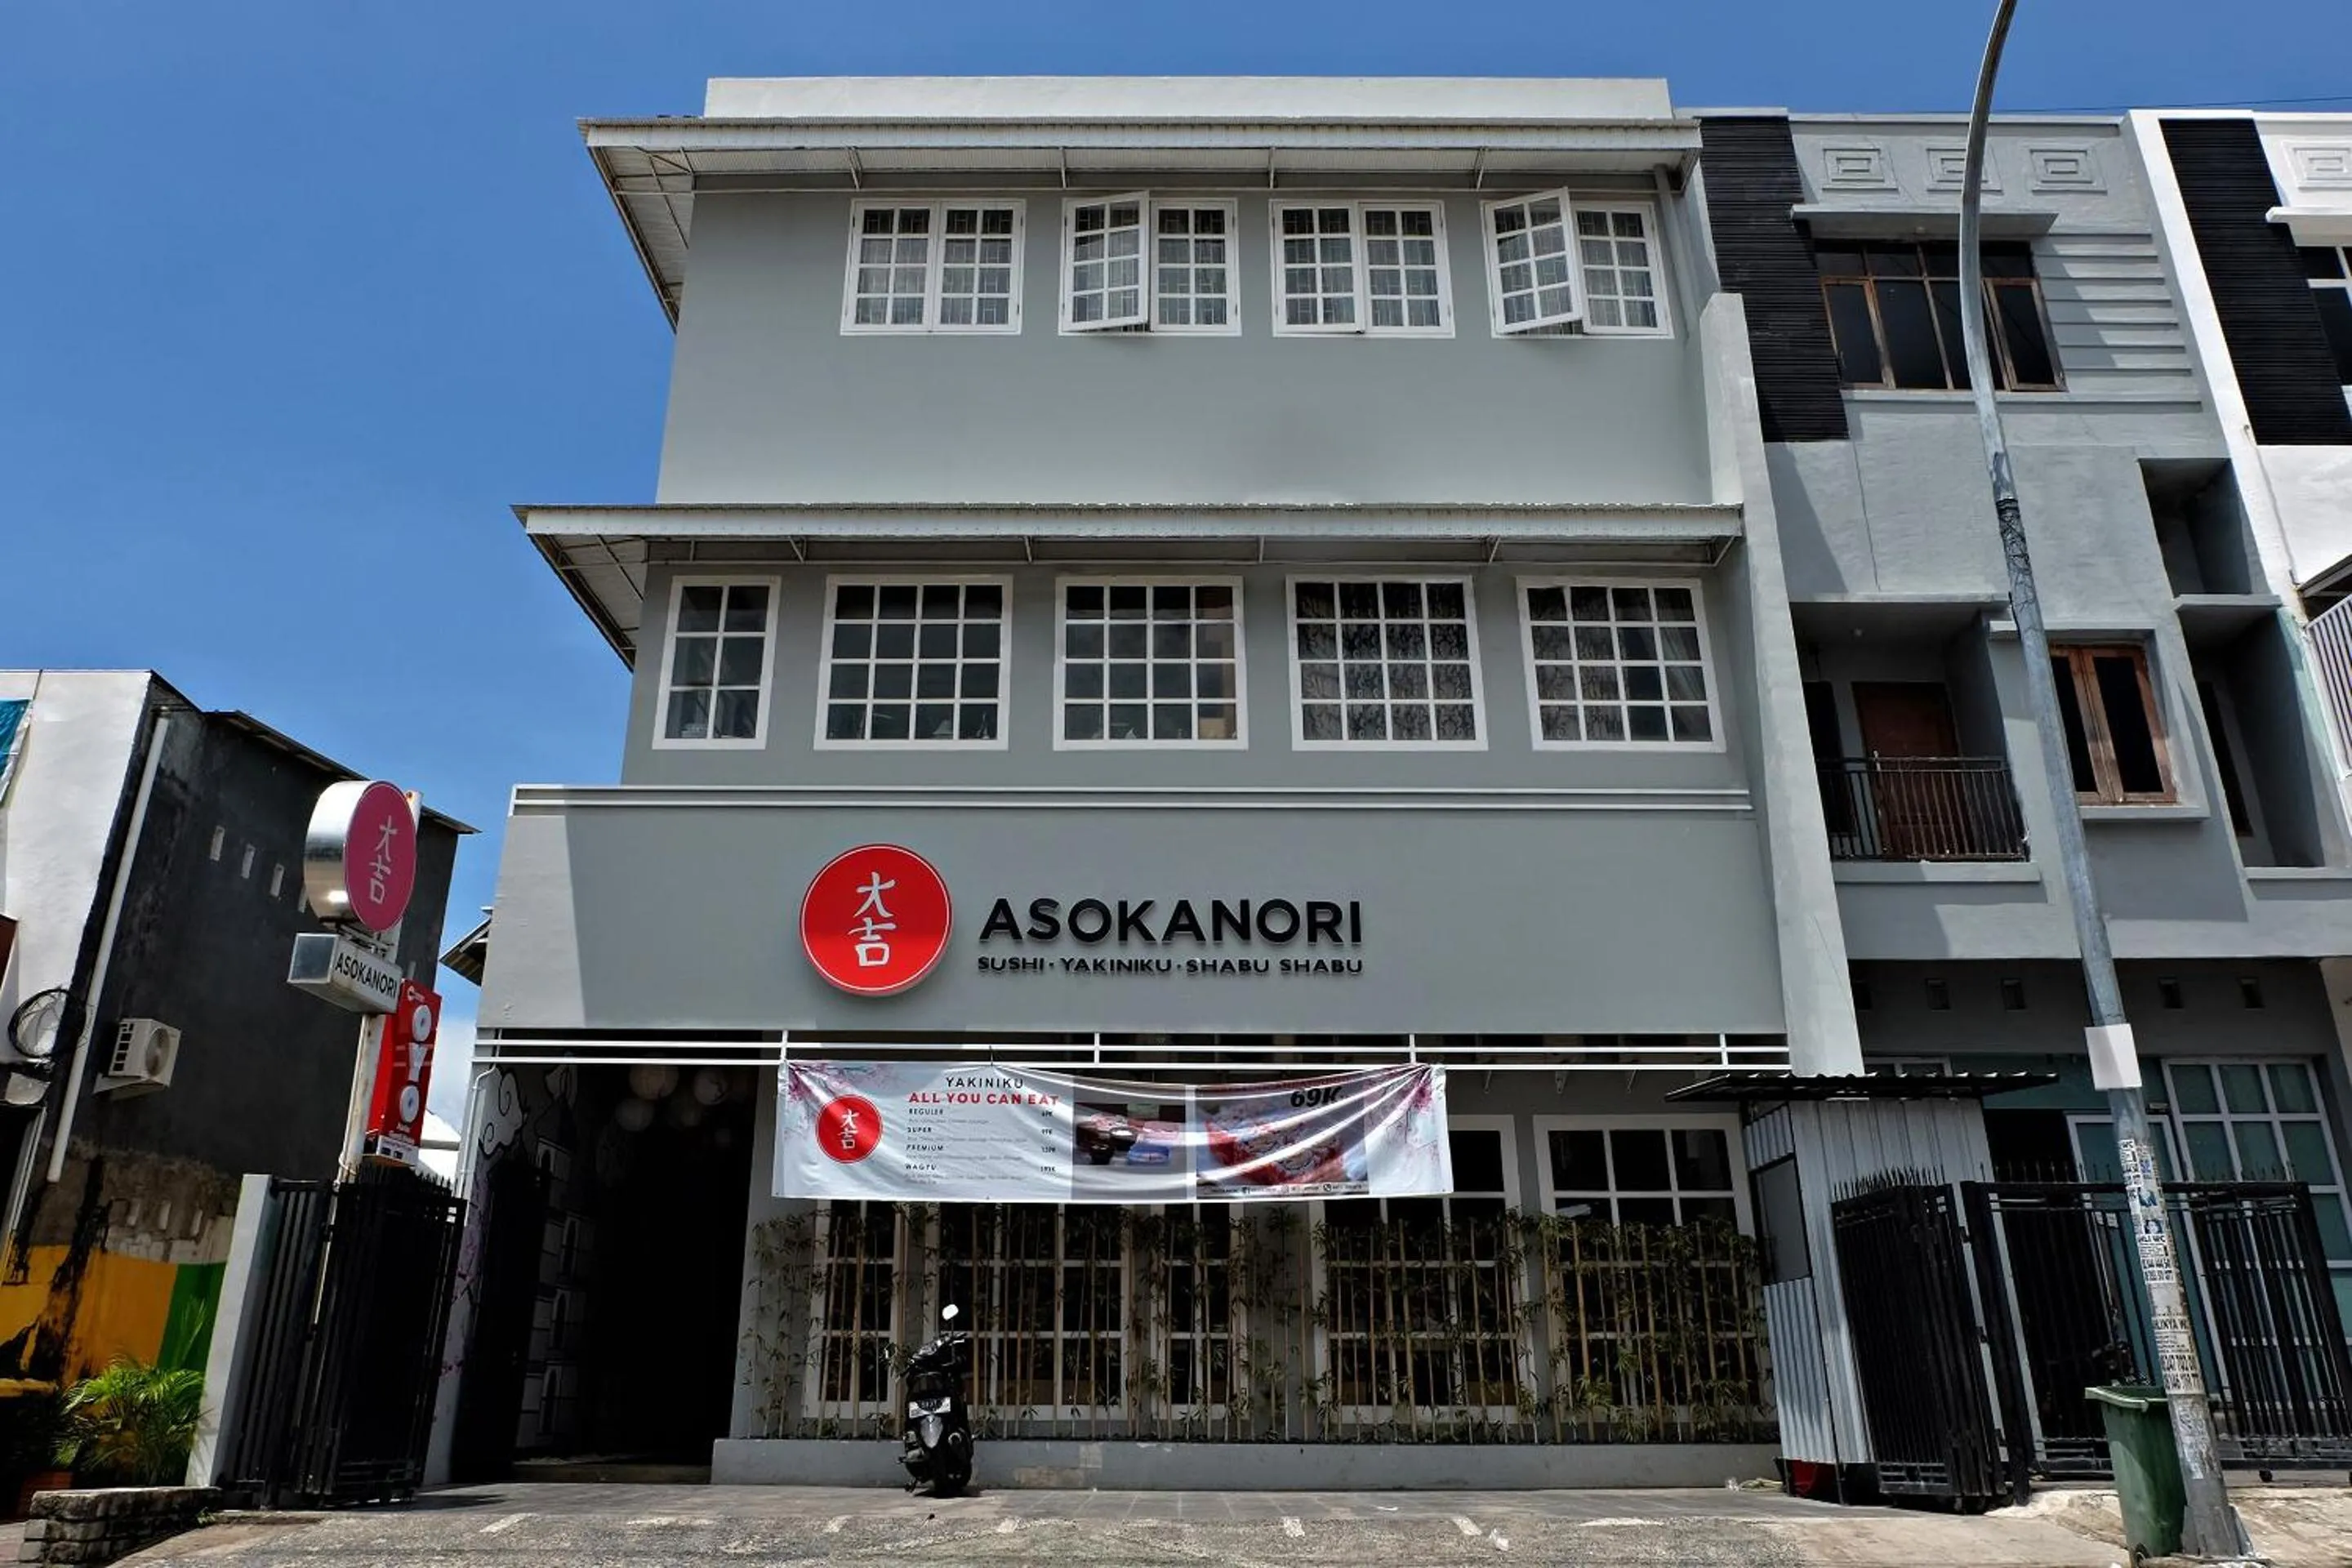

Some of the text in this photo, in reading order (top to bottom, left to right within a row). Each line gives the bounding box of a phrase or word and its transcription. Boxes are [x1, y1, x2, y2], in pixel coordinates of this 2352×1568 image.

[369, 815, 398, 904] 大吉
[848, 871, 897, 967] 大吉
[980, 898, 1361, 944] ASOKANORI
[335, 952, 398, 998] ASOKANORI
[978, 956, 1362, 973] SUSHI YAKINIKU SHABU SHABU
[399, 1004, 432, 1124] OYO
[946, 1076, 1023, 1089] YAKINIKU
[909, 1092, 1058, 1106] ALL YOU CAN EAT
[1290, 1086, 1342, 1107] 69K
[837, 1108, 859, 1150] 大吉
